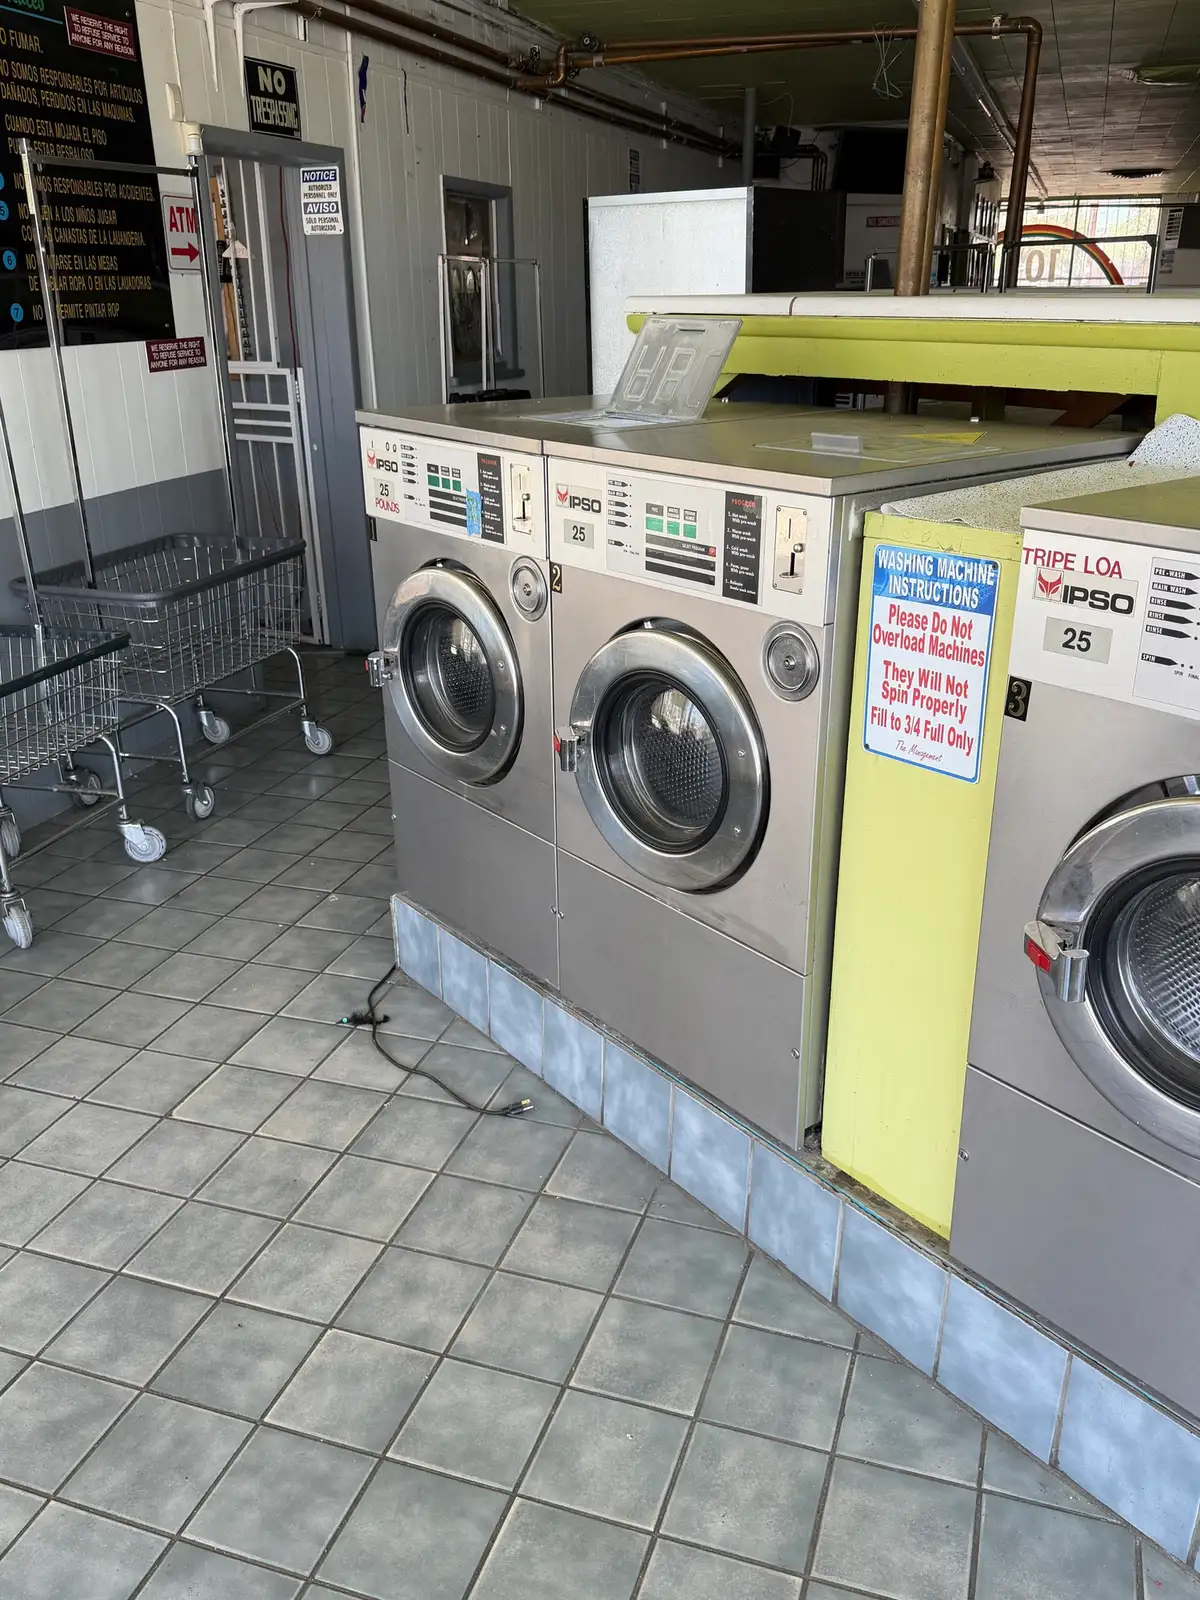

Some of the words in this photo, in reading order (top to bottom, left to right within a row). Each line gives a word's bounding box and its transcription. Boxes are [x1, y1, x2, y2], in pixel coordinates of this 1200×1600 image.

[71, 13, 80, 23] WE
[80, 15, 103, 30] RESERVE
[102, 20, 114, 33] THE
[114, 25, 129, 36] RIGHT
[73, 23, 81, 33] TO
[81, 26, 101, 38] REFUSE
[101, 30, 122, 43] SERVICE
[121, 36, 130, 46] TO
[71, 33, 93, 46] ANYONE
[92, 38, 103, 48] FOR
[103, 42, 114, 51] ANY
[11, 61, 39, 83] SOMOS
[40, 67, 93, 94] RESPONSABLES
[93, 79, 109, 98] POR
[257, 65, 286, 96] NO
[41, 89, 76, 112] PERDIDOS
[77, 96, 88, 114] EN
[87, 98, 101, 117] LAS
[250, 95, 299, 129] TRESPASSING
[4, 113, 35, 135] CUANDO
[36, 118, 54, 138] ESTA
[54, 122, 82, 142] MOJADA
[82, 126, 91, 144] EL
[92, 128, 107, 146] PISO
[13, 172, 25, 190] NO
[53, 177, 103, 197] RESPONSABLES
[104, 181, 118, 199] POR
[303, 170, 336, 181] NOTICE
[17, 202, 30, 220] NO
[54, 205, 61, 221] A
[61, 205, 75, 223] LOS
[169, 205, 198, 234] ATM
[306, 202, 337, 214] AVISO
[53, 226, 88, 244] CANASTAS
[88, 228, 98, 244] DE
[98, 229, 108, 245] LA
[25, 253, 37, 270] NO
[73, 254, 84, 271] EN
[83, 254, 97, 271] LAS
[97, 255, 119, 271] MESAS
[28, 275, 40, 292] DE
[69, 275, 87, 291] ROPA
[94, 275, 104, 291] EN
[104, 275, 117, 291] LAS
[32, 304, 44, 321] NO
[151, 344, 159, 352] WE
[158, 342, 179, 351] RESERVE
[178, 341, 188, 350] THE
[188, 340, 201, 349] RIGHT
[153, 352, 160, 360] TO
[160, 351, 177, 359] REFUSE
[177, 349, 195, 358] SERVICE
[195, 348, 202, 356] TO
[151, 360, 169, 369] ANYONE
[168, 358, 179, 367] FOR
[178, 357, 188, 366] ANY
[376, 458, 398, 473] IPSO
[379, 483, 390, 497] 25
[375, 497, 400, 514] POUNDS
[569, 495, 602, 514] IPSO
[572, 525, 586, 542] 25
[878, 549, 934, 576] WASHING
[937, 557, 994, 586] MACHINE
[1023, 547, 1076, 571] TRIPE
[1083, 555, 1122, 579] LOA
[552, 564, 561, 592] 2
[1153, 583, 1169, 592] MAIN
[1169, 585, 1187, 596] WASH
[888, 574, 979, 609] INSTRUCTIONS
[1062, 585, 1134, 615] IPSO
[1150, 597, 1167, 606] RINSE
[889, 603, 928, 631] Please
[931, 611, 947, 635] Do
[950, 615, 973, 641] Not
[1148, 611, 1165, 620] RINSE
[1062, 627, 1092, 652] 25
[1146, 625, 1163, 634] RINSE
[873, 623, 926, 654] Overload
[928, 634, 985, 668] Machines
[1142, 653, 1156, 662] SPIN
[883, 660, 914, 690] They
[918, 667, 942, 692] Will
[945, 674, 969, 699] Not
[881, 680, 908, 705] Spin
[912, 688, 967, 724] Properly
[1008, 681, 1027, 717] 3
[871, 706, 888, 728] Fill
[890, 711, 901, 731] to
[904, 714, 920, 737] 3/4
[923, 719, 945, 743] Full
[947, 726, 974, 757] Only
[896, 739, 907, 752] The
[908, 743, 943, 762] Management
